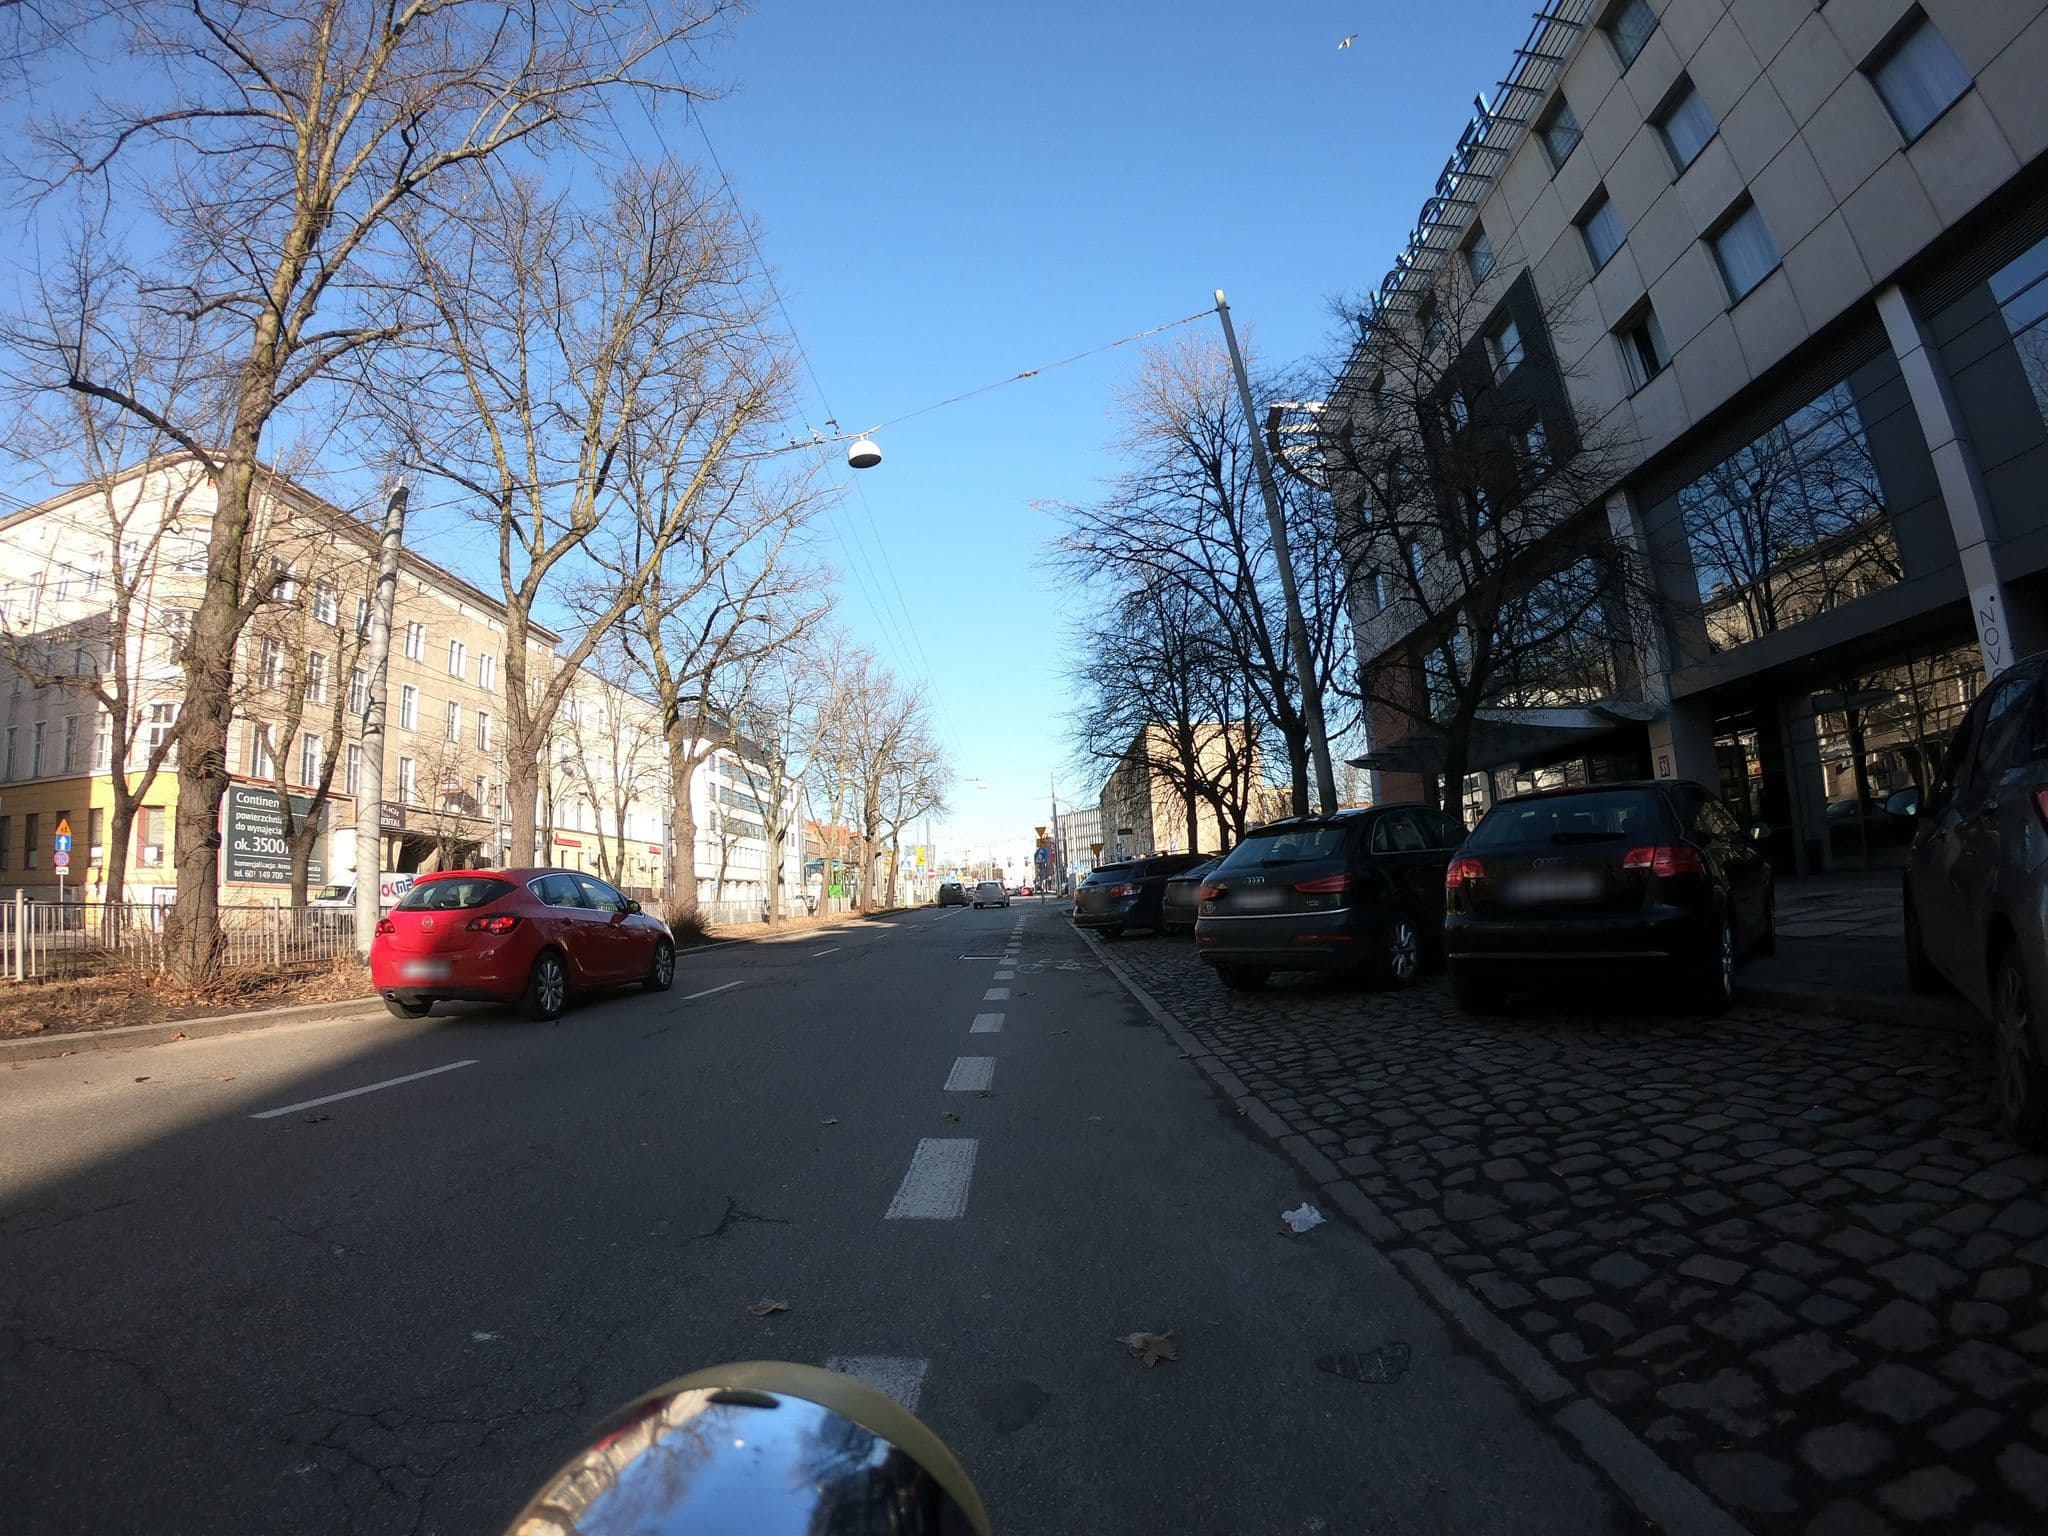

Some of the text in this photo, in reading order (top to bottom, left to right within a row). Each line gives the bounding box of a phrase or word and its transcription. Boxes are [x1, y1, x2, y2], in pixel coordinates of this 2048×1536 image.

[236, 792, 280, 808] Continen
[235, 822, 246, 831] do
[234, 838, 251, 851] ok.
[252, 837, 285, 854] 3500
